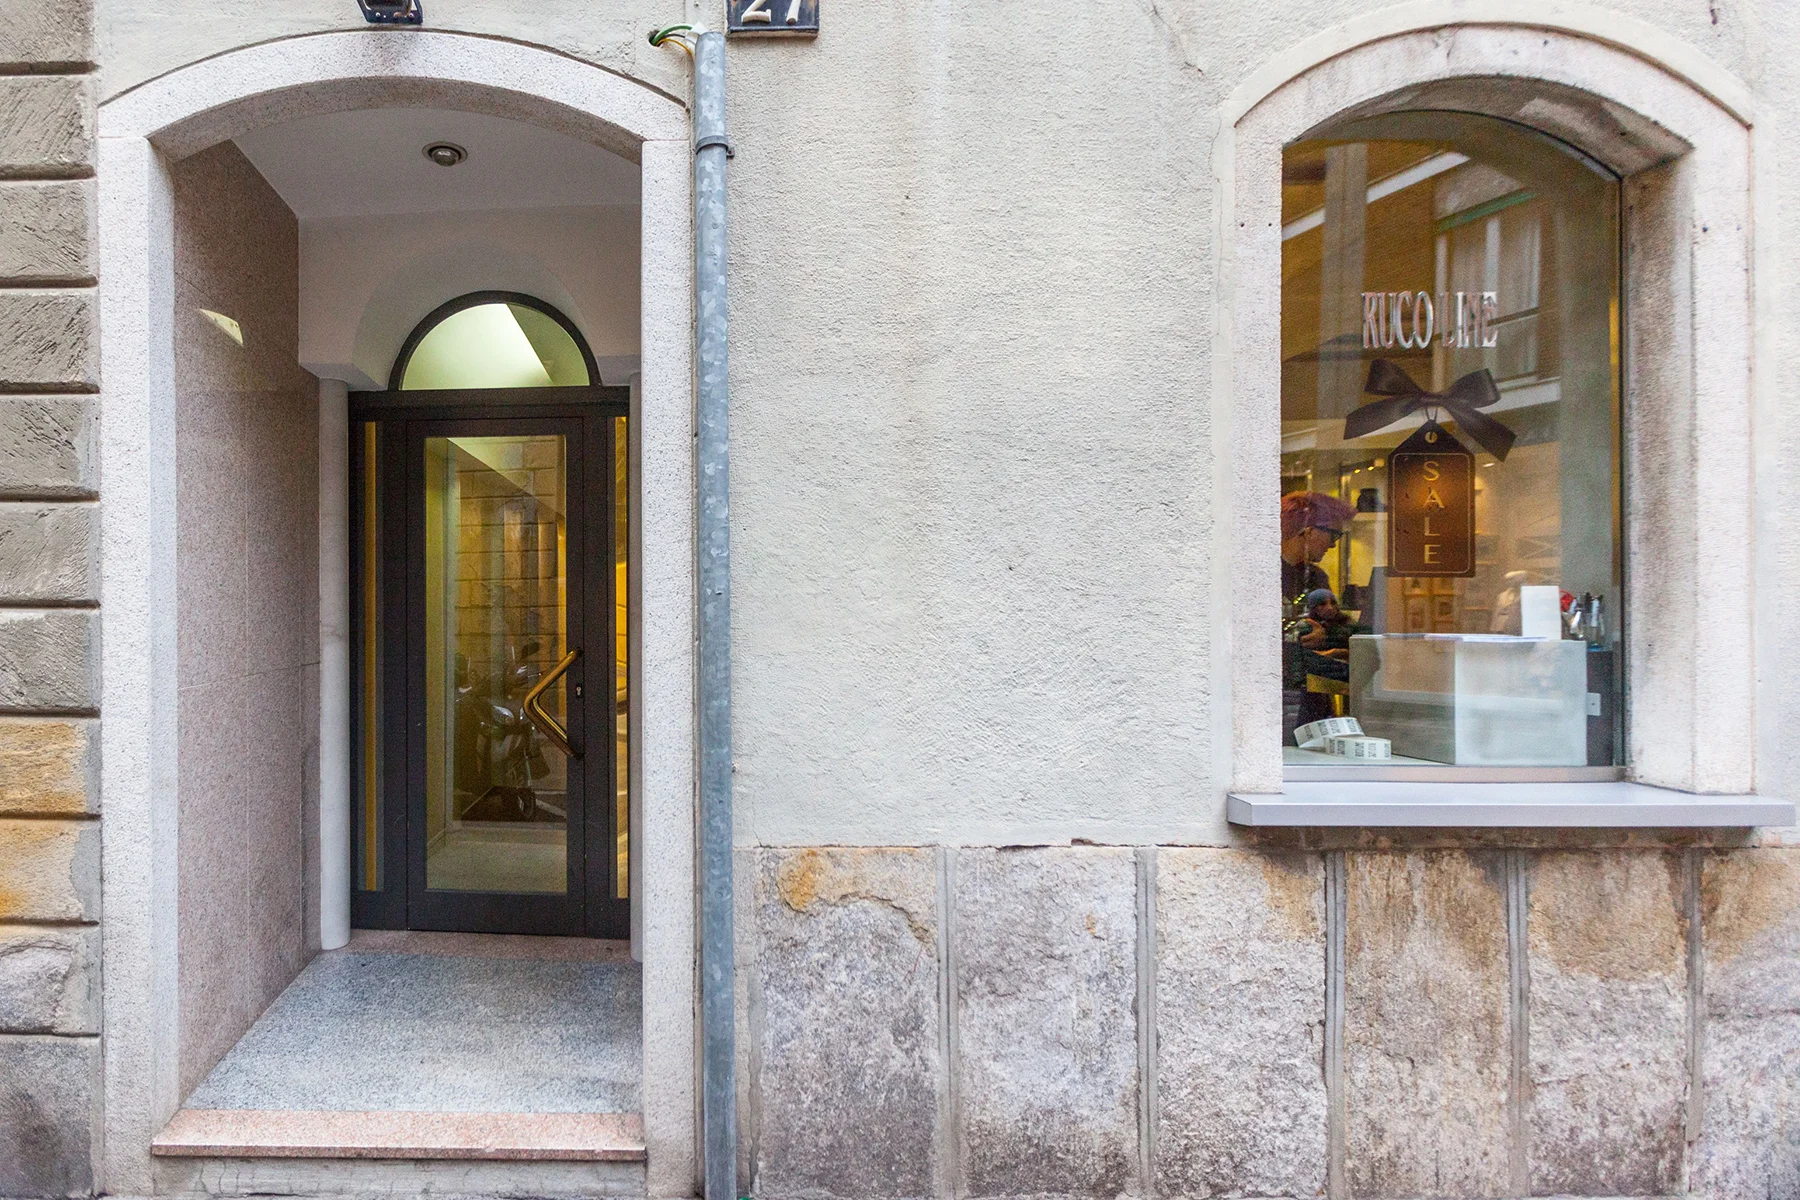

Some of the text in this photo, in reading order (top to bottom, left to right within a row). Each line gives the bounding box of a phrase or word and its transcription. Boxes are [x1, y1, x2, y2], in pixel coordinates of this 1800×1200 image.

[1361, 291, 1498, 349] RUCO LINE
[1423, 461, 1445, 564] SALE
